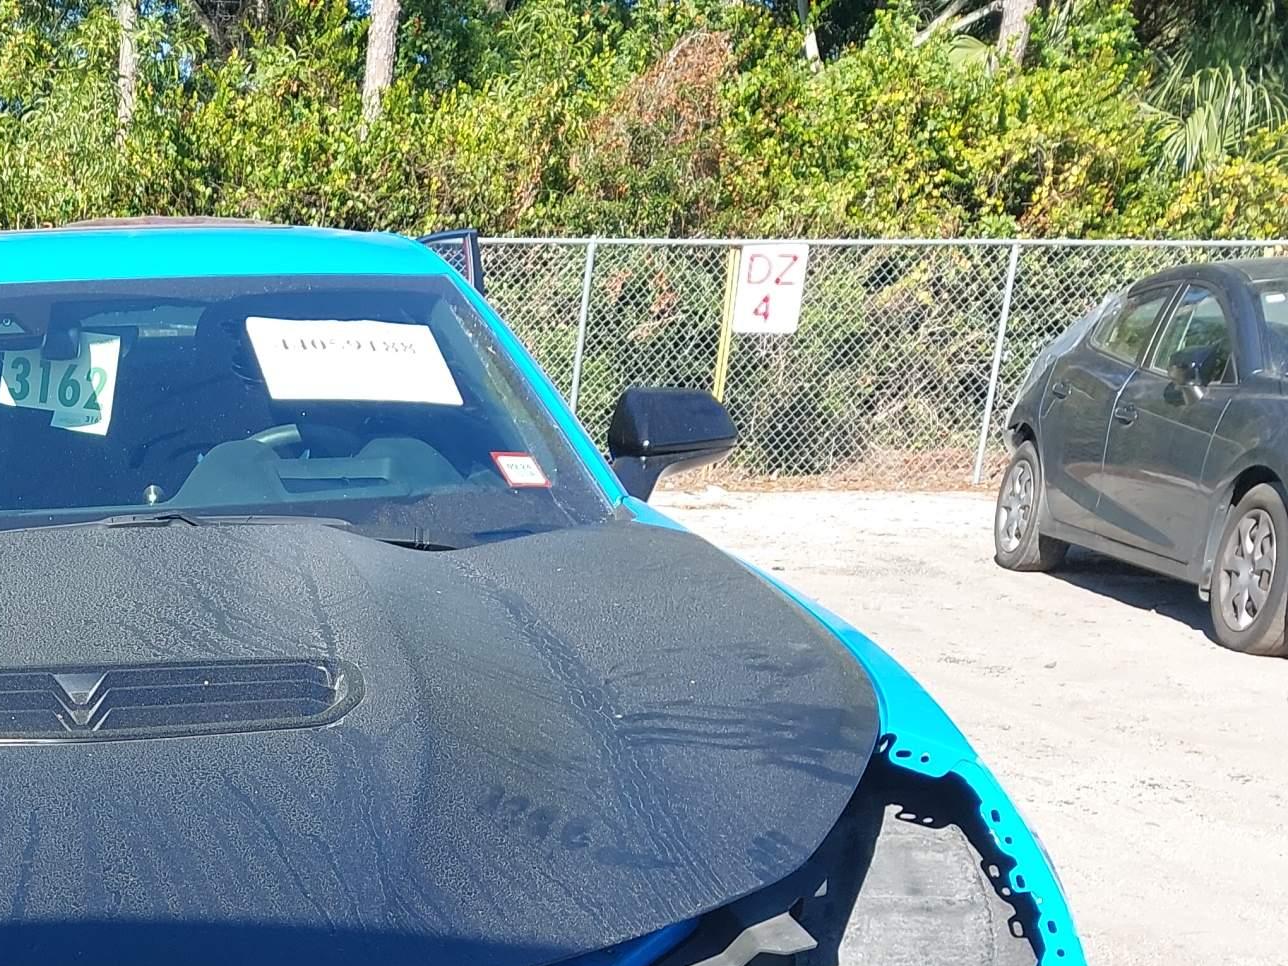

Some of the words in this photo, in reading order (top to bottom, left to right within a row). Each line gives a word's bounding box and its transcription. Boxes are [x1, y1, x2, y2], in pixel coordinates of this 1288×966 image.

[746, 253, 798, 285] DZ
[752, 294, 770, 321] 4
[7, 356, 107, 410] 3162
